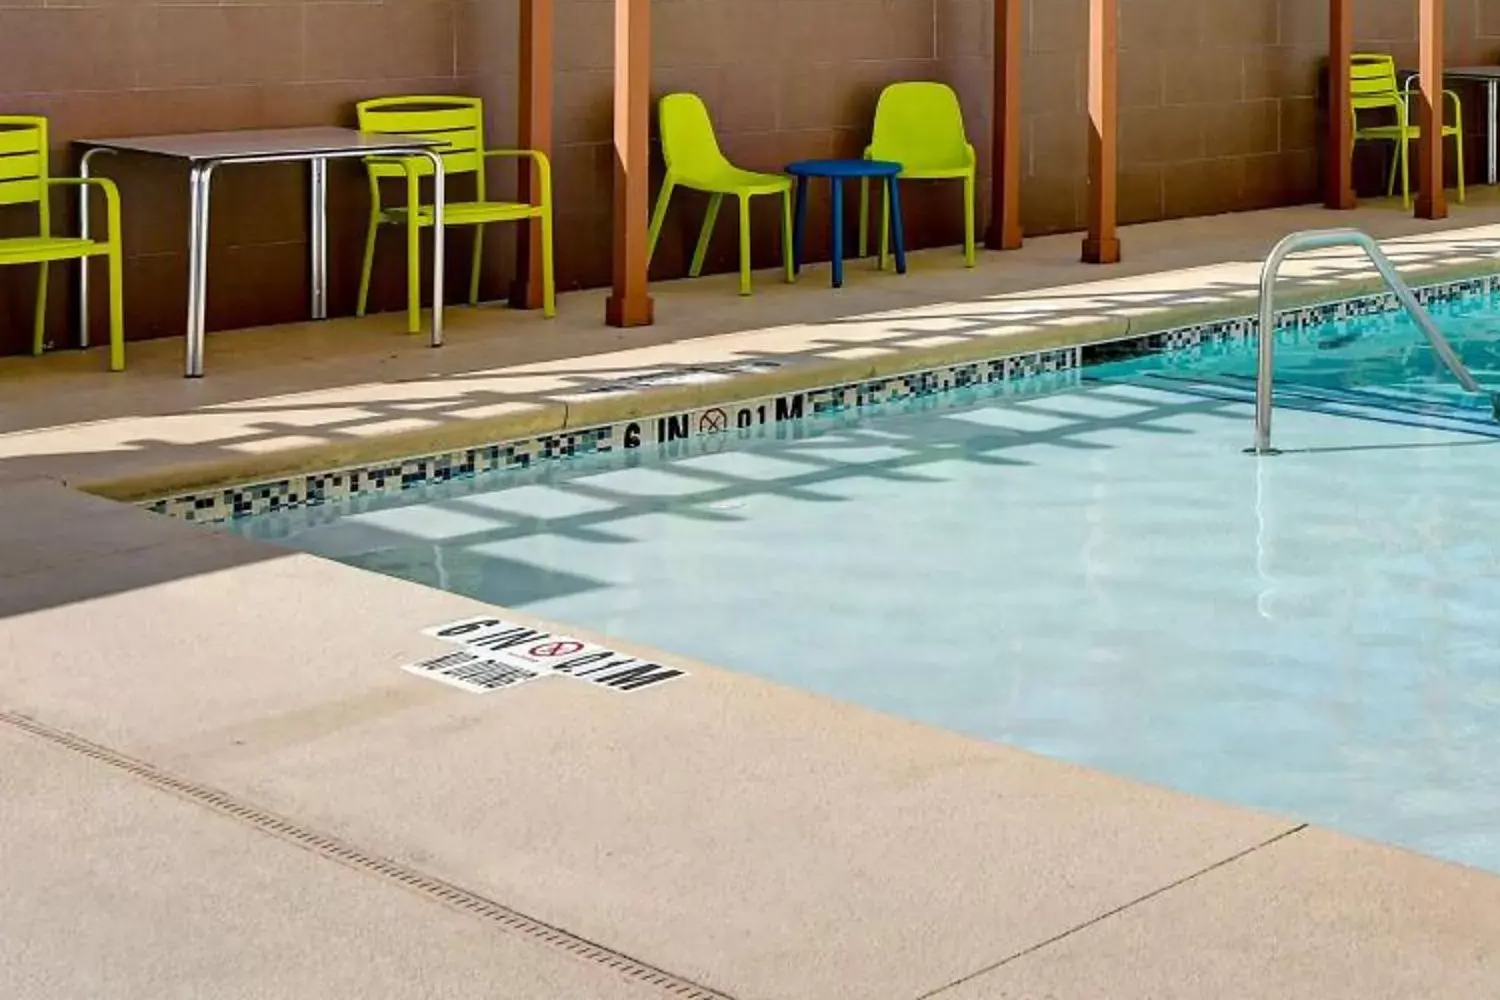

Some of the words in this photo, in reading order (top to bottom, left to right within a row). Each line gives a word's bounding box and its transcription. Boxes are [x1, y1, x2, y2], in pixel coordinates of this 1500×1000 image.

[623, 422, 641, 448] 6
[657, 413, 689, 443] IN
[775, 393, 802, 421] M
[437, 619, 501, 637] 6
[465, 626, 551, 651] IN
[594, 662, 685, 691] M
